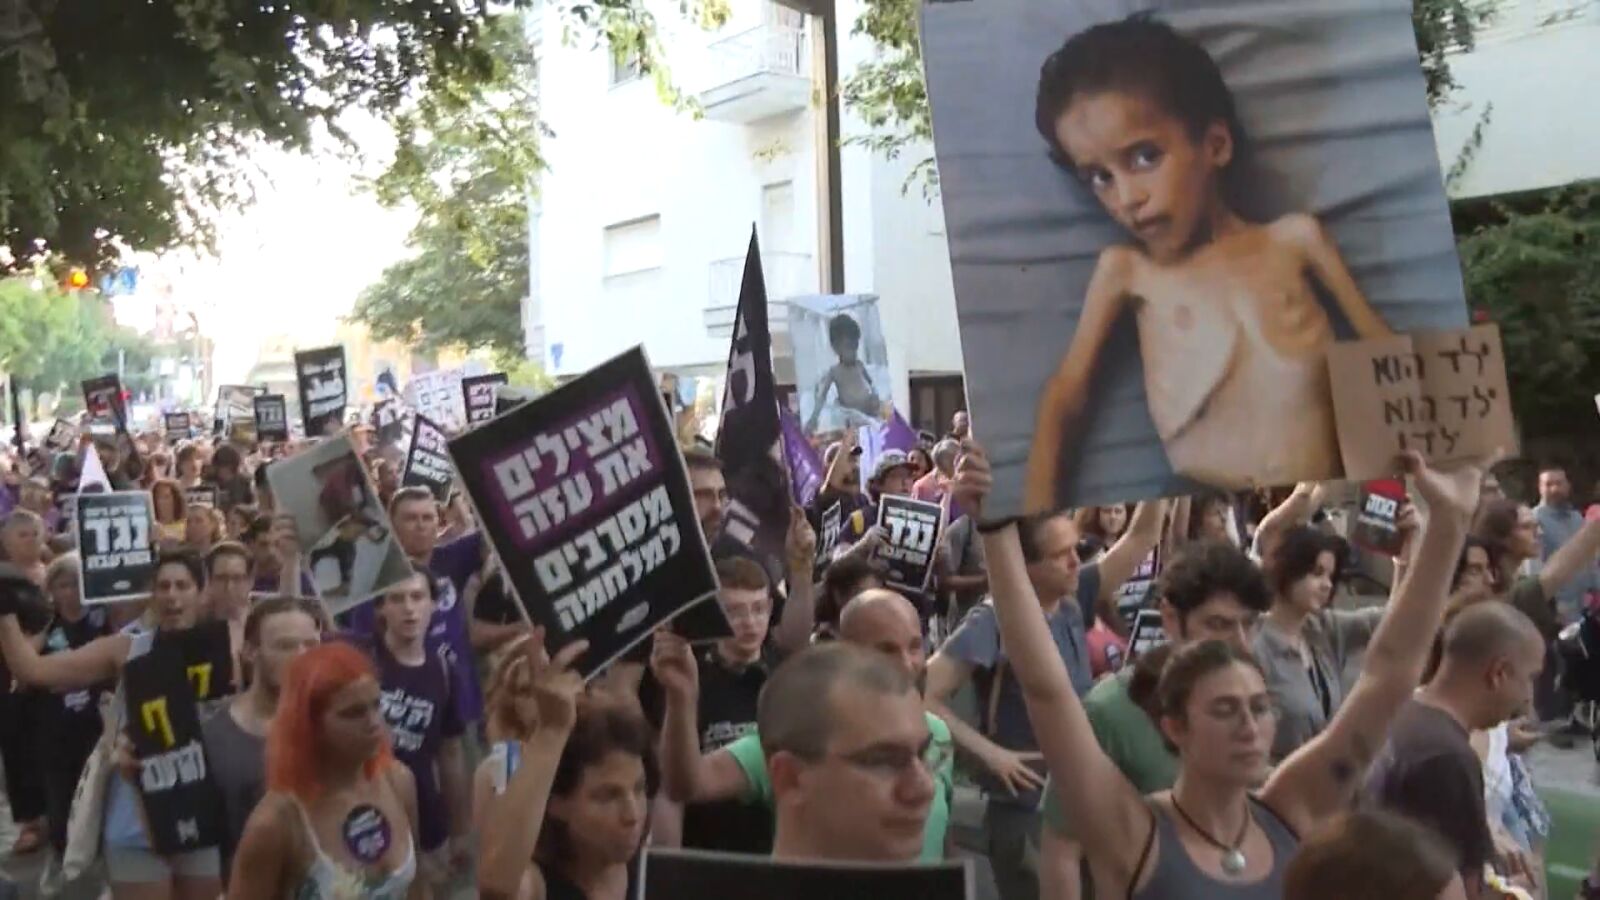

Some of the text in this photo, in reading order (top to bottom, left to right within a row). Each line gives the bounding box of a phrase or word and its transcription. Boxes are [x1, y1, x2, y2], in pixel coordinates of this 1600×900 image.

[1372, 336, 1490, 385] ילד הוא
[1384, 386, 1497, 424] ילד הוא
[494, 397, 638, 501] מצילים
[513, 437, 653, 539] את עזה
[84, 515, 149, 555] נגד
[533, 485, 674, 594] מסרבים
[886, 516, 934, 552] נגד
[553, 522, 680, 631] למלחמה
